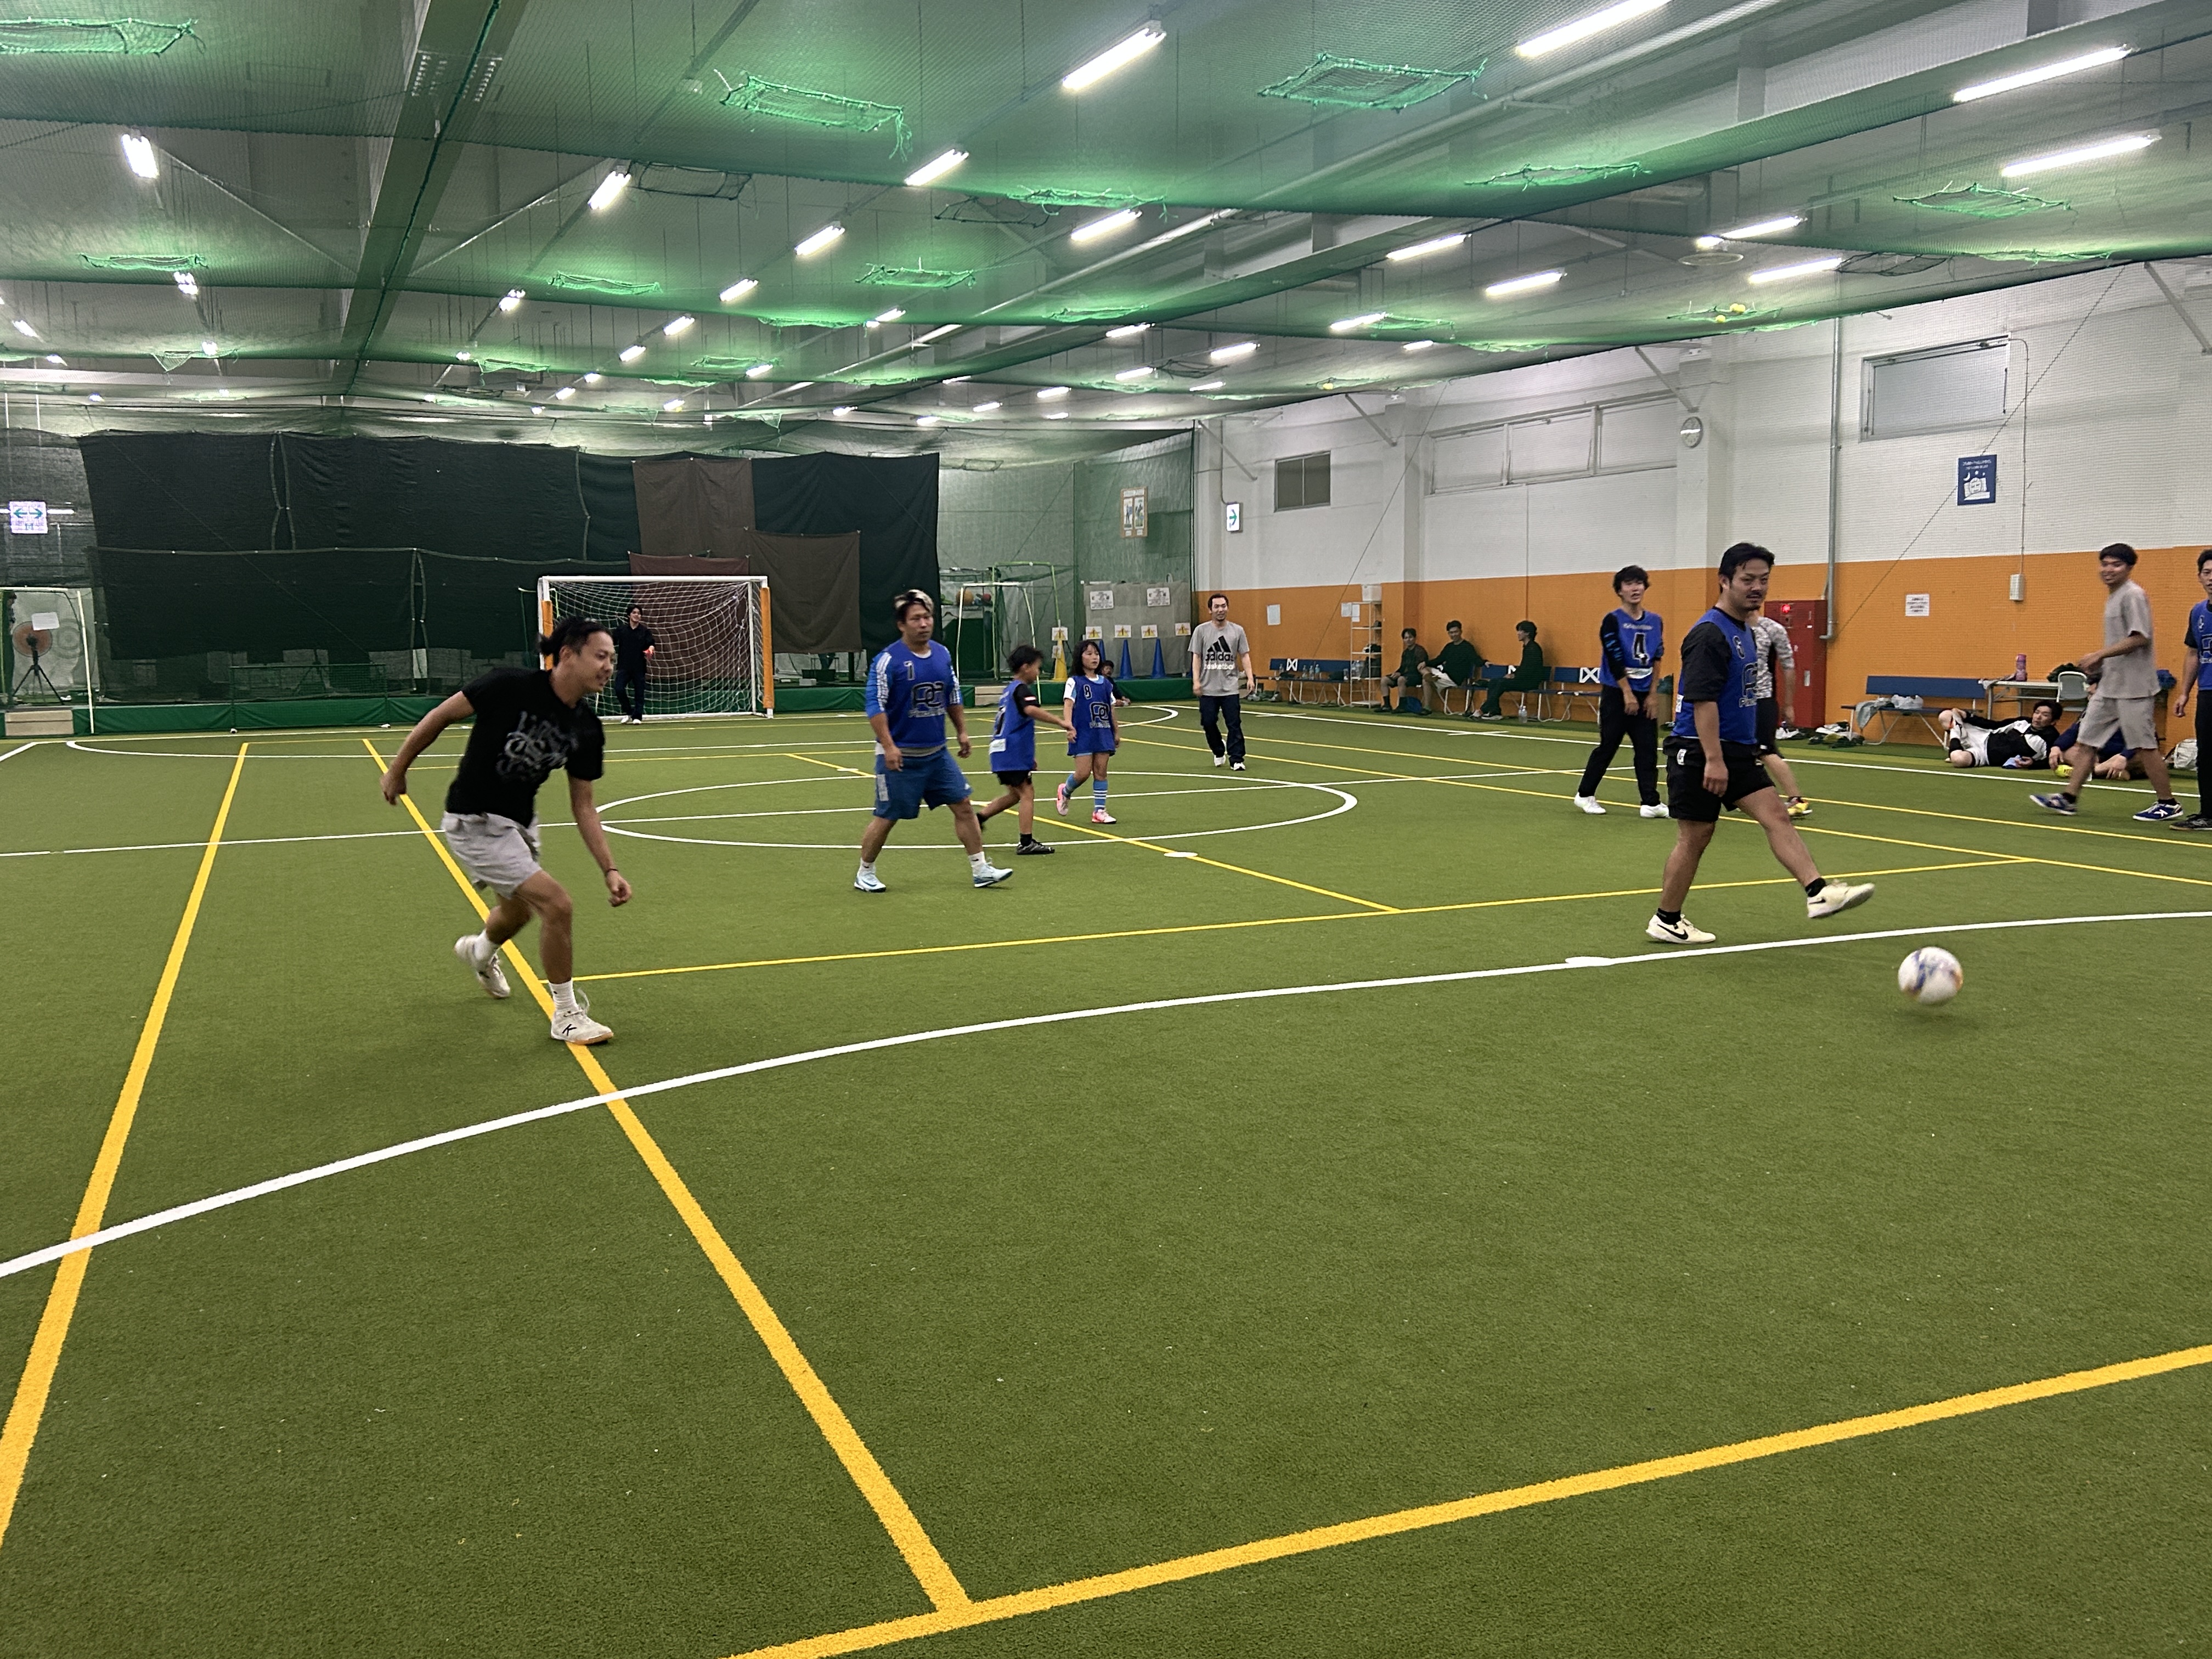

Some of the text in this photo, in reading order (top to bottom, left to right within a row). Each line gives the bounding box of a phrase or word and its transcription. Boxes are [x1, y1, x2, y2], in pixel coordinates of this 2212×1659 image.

[1632, 632, 1650, 666] 4
[904, 660, 916, 681] 1
[1083, 684, 1092, 700] 8
